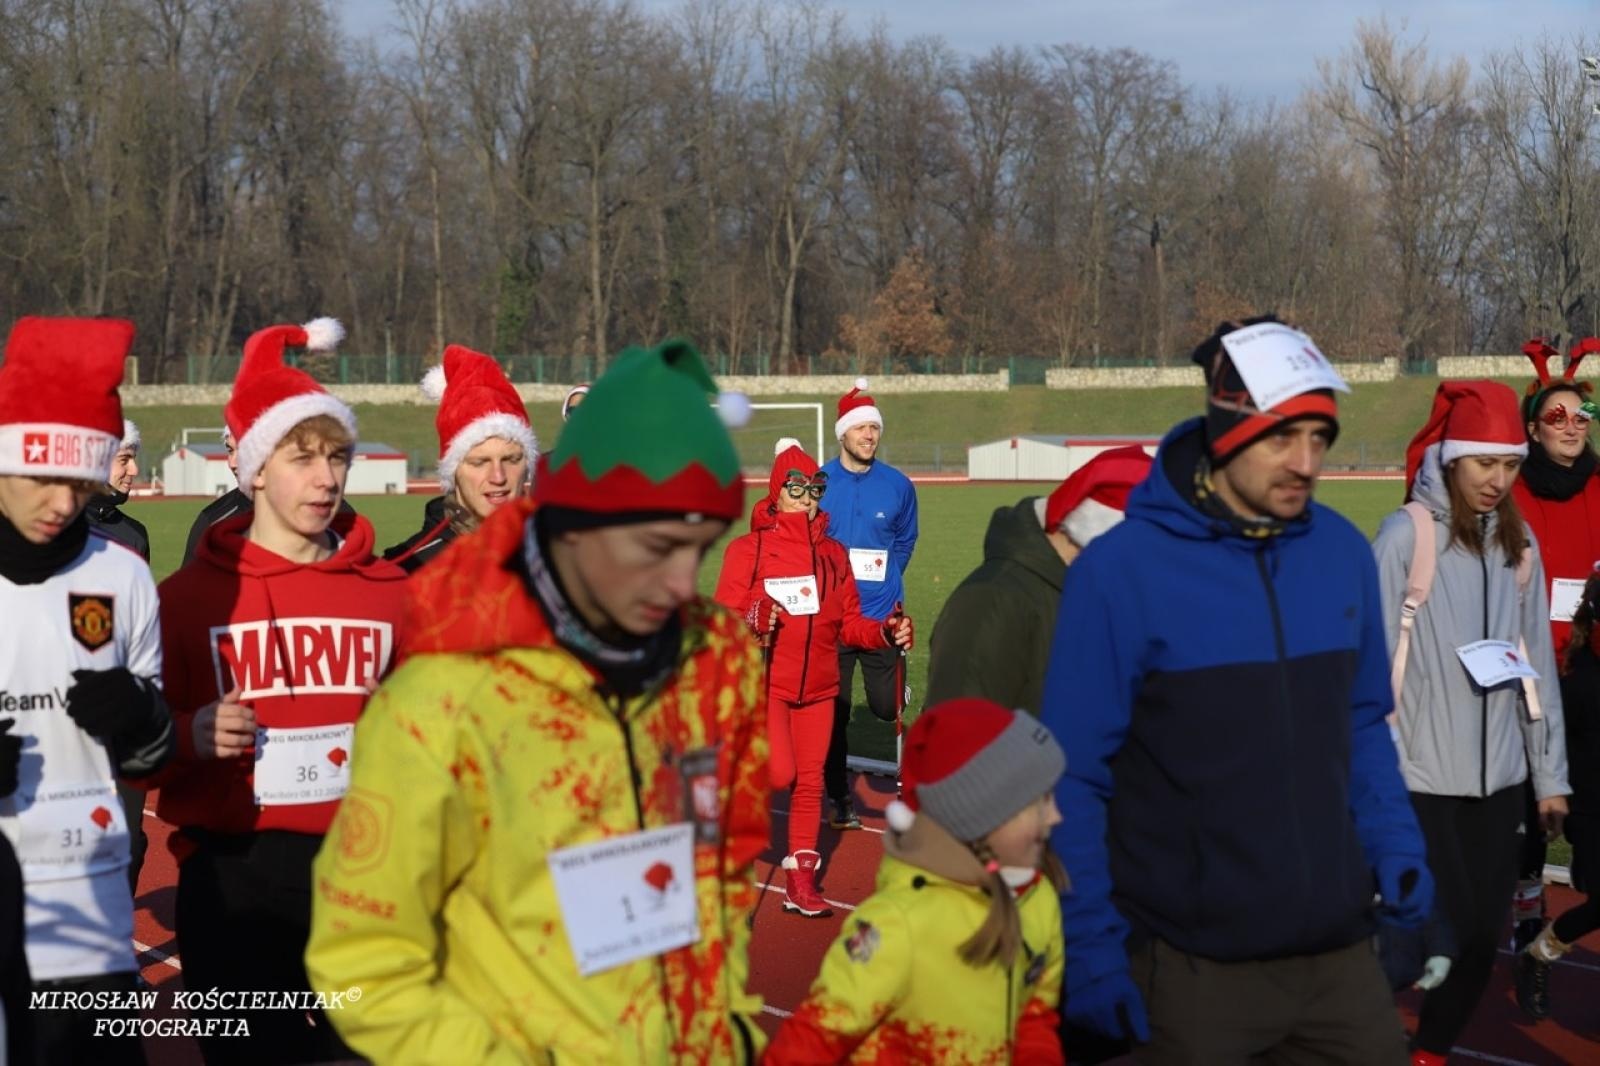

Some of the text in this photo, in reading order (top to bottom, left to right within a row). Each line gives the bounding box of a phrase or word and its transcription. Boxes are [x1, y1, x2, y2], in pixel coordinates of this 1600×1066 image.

[54, 434, 81, 466] BIG
[786, 595, 798, 604] 33
[296, 765, 318, 782] 36
[61, 829, 84, 848] 31
[621, 894, 635, 923] 1
